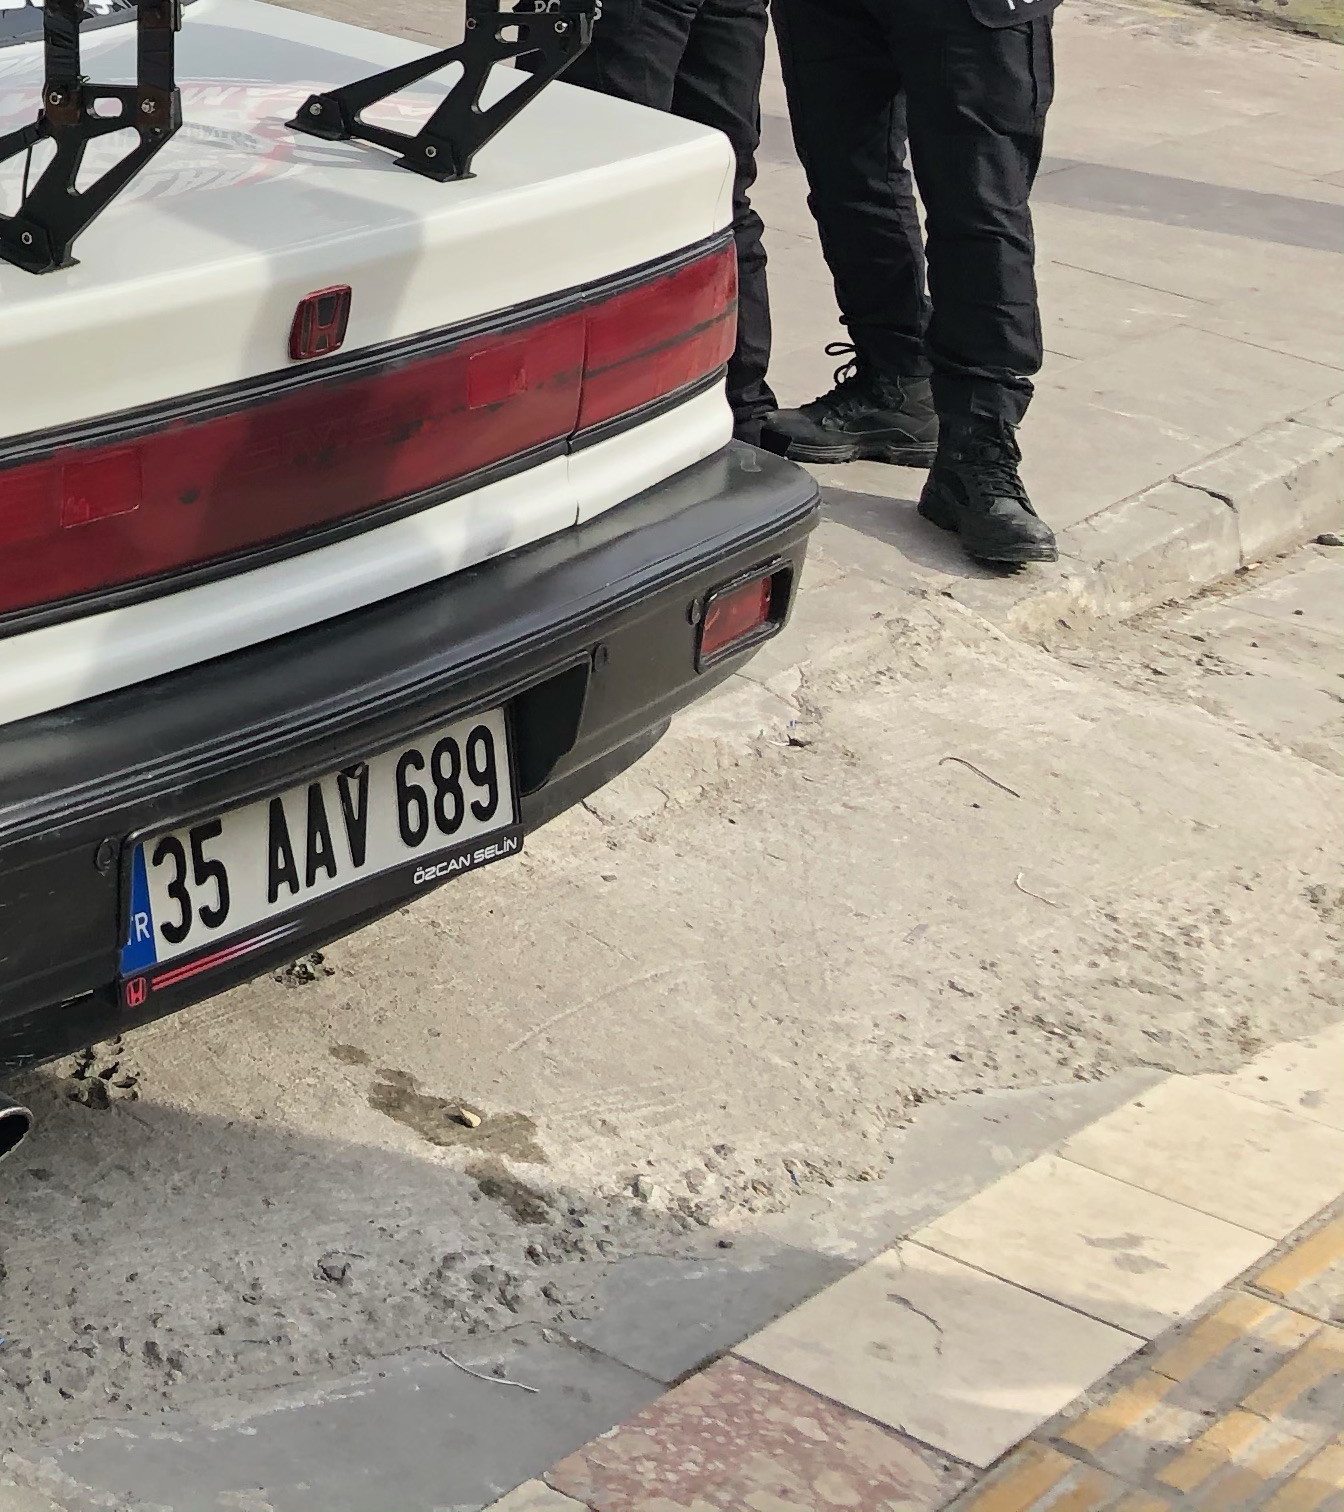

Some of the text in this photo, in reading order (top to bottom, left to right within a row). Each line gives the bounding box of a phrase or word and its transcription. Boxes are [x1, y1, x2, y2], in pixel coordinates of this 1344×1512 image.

[151, 724, 500, 945] 35 AAV 689
[412, 835, 519, 886] ÖZCAN SELİN
